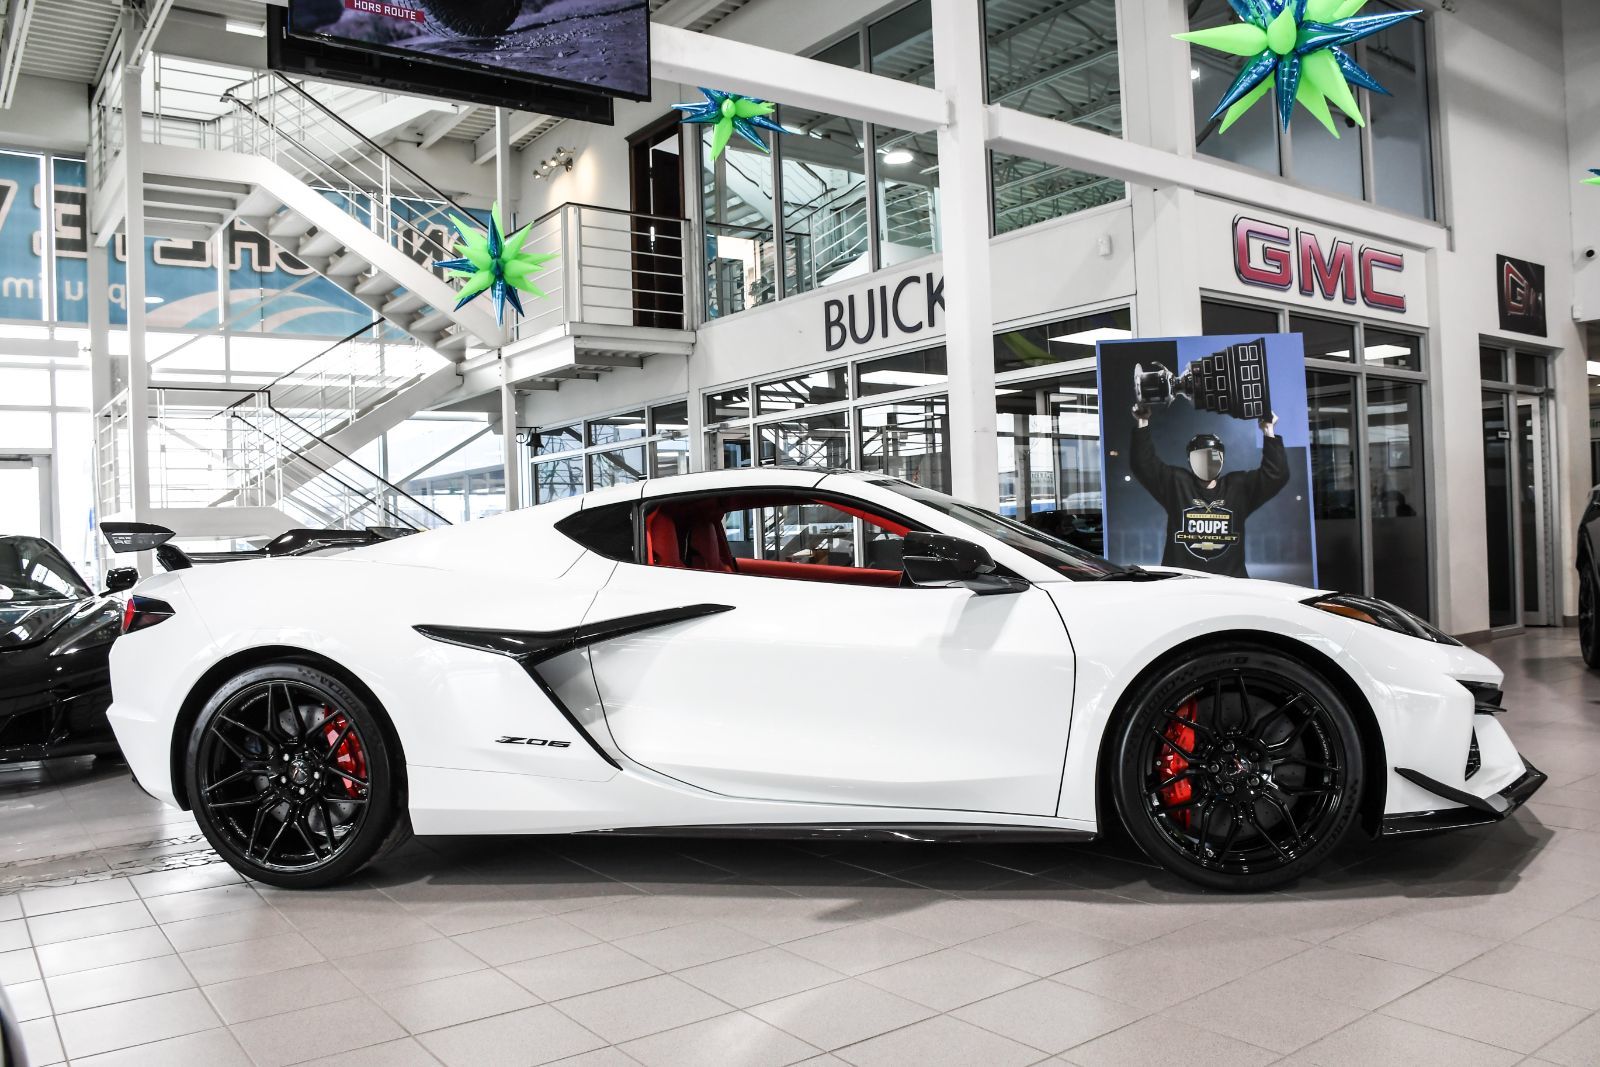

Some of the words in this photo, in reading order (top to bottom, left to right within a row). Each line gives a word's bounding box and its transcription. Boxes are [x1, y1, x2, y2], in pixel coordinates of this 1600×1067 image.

[354, 0, 381, 13] HORS
[384, 6, 416, 20] ROUTE
[1232, 213, 1406, 313] GMC
[824, 272, 945, 352] BUICK
[1187, 519, 1229, 534] COUPE
[495, 735, 572, 748] Z06
